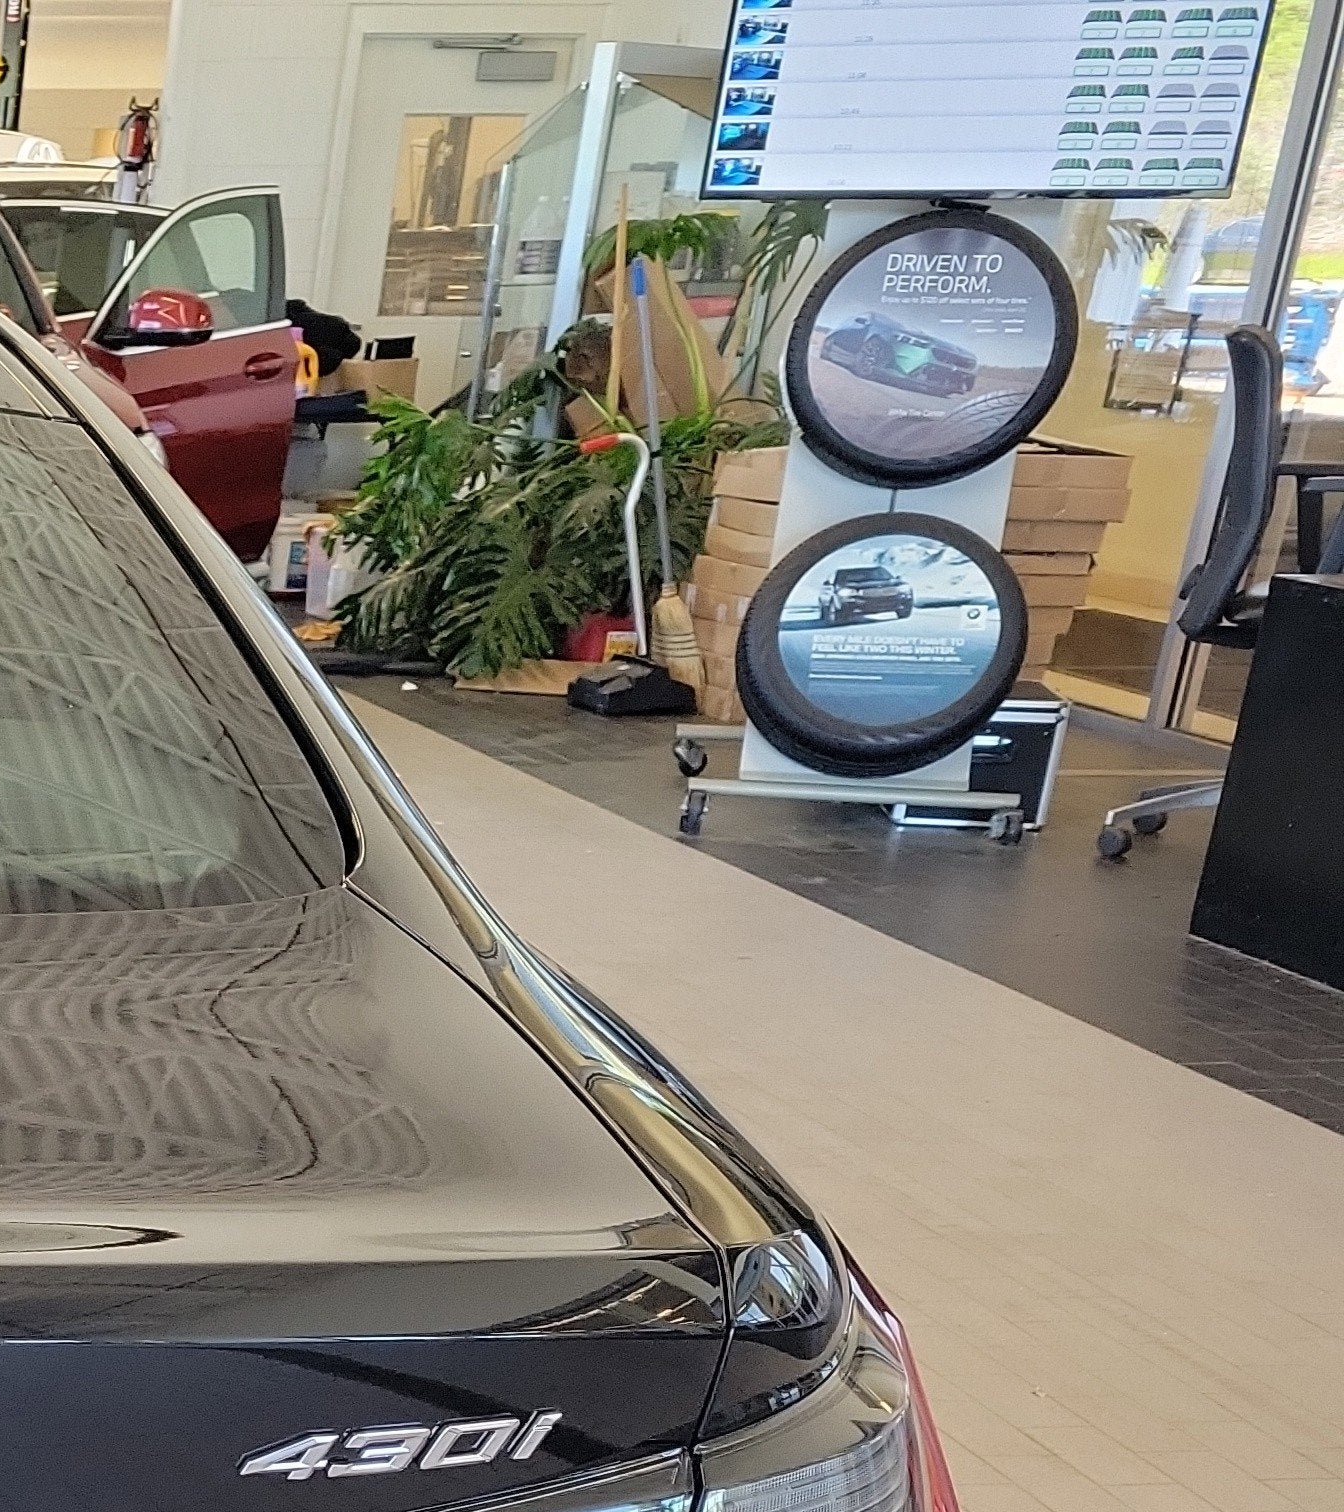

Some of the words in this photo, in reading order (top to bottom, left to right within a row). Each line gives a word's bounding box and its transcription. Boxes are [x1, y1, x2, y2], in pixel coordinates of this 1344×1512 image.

[886, 253, 968, 273] DRIVEN
[973, 254, 1003, 273] TO
[882, 274, 992, 294] PERFORM.
[951, 637, 965, 646] TO
[238, 1410, 562, 1480] 430i
